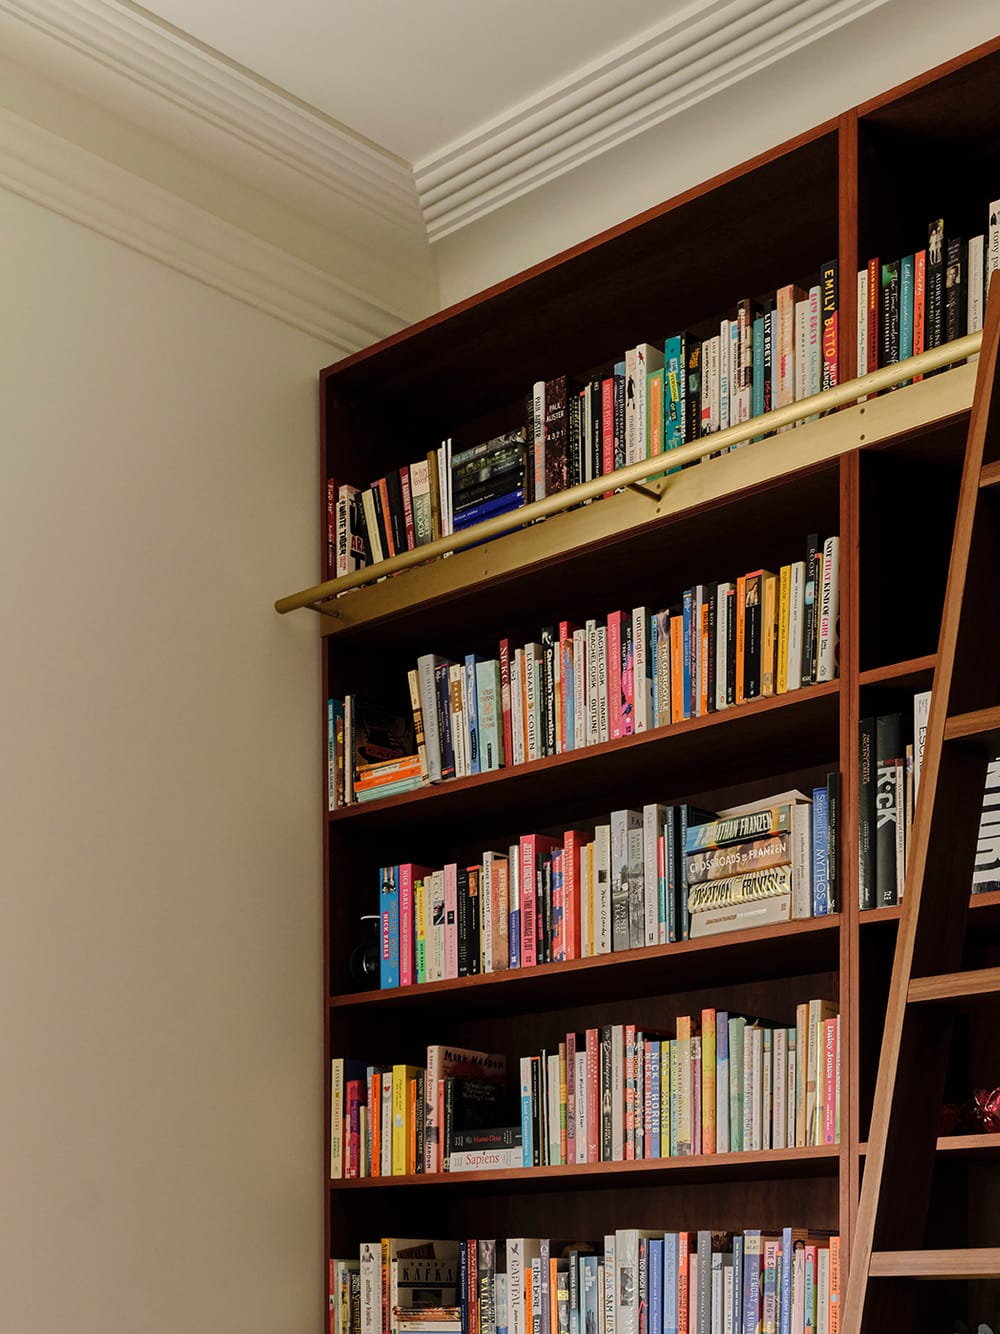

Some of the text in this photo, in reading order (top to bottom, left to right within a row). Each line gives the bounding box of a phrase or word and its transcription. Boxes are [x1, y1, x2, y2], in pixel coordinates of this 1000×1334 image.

[991, 230, 1000, 253] tony
[823, 269, 835, 357] EMILY BITTO
[764, 313, 772, 368] LILY BRETT
[829, 363, 837, 387] WILD
[534, 396, 542, 413] PAUL
[339, 508, 347, 555] WHITE TIGER
[808, 548, 816, 577] ROOM
[821, 541, 833, 637] NOT THAT KIND OF GIRL
[597, 630, 605, 662] RACHEL
[635, 616, 644, 665] untangled
[526, 652, 534, 701] LEONARD
[547, 693, 555, 746] Tarantino
[748, 842, 786, 861] FRANZEN
[815, 794, 826, 901] Stephen Fry MYTHOS
[524, 900, 532, 951] THE MARRIAGE PLOT
[826, 1025, 834, 1050] Daisy
[466, 1153, 500, 1168] Sapiens
[403, 1267, 453, 1281] KAFKA
[532, 1266, 541, 1283] the
[481, 1276, 489, 1310] WALLY
[532, 1285, 541, 1308] boat
